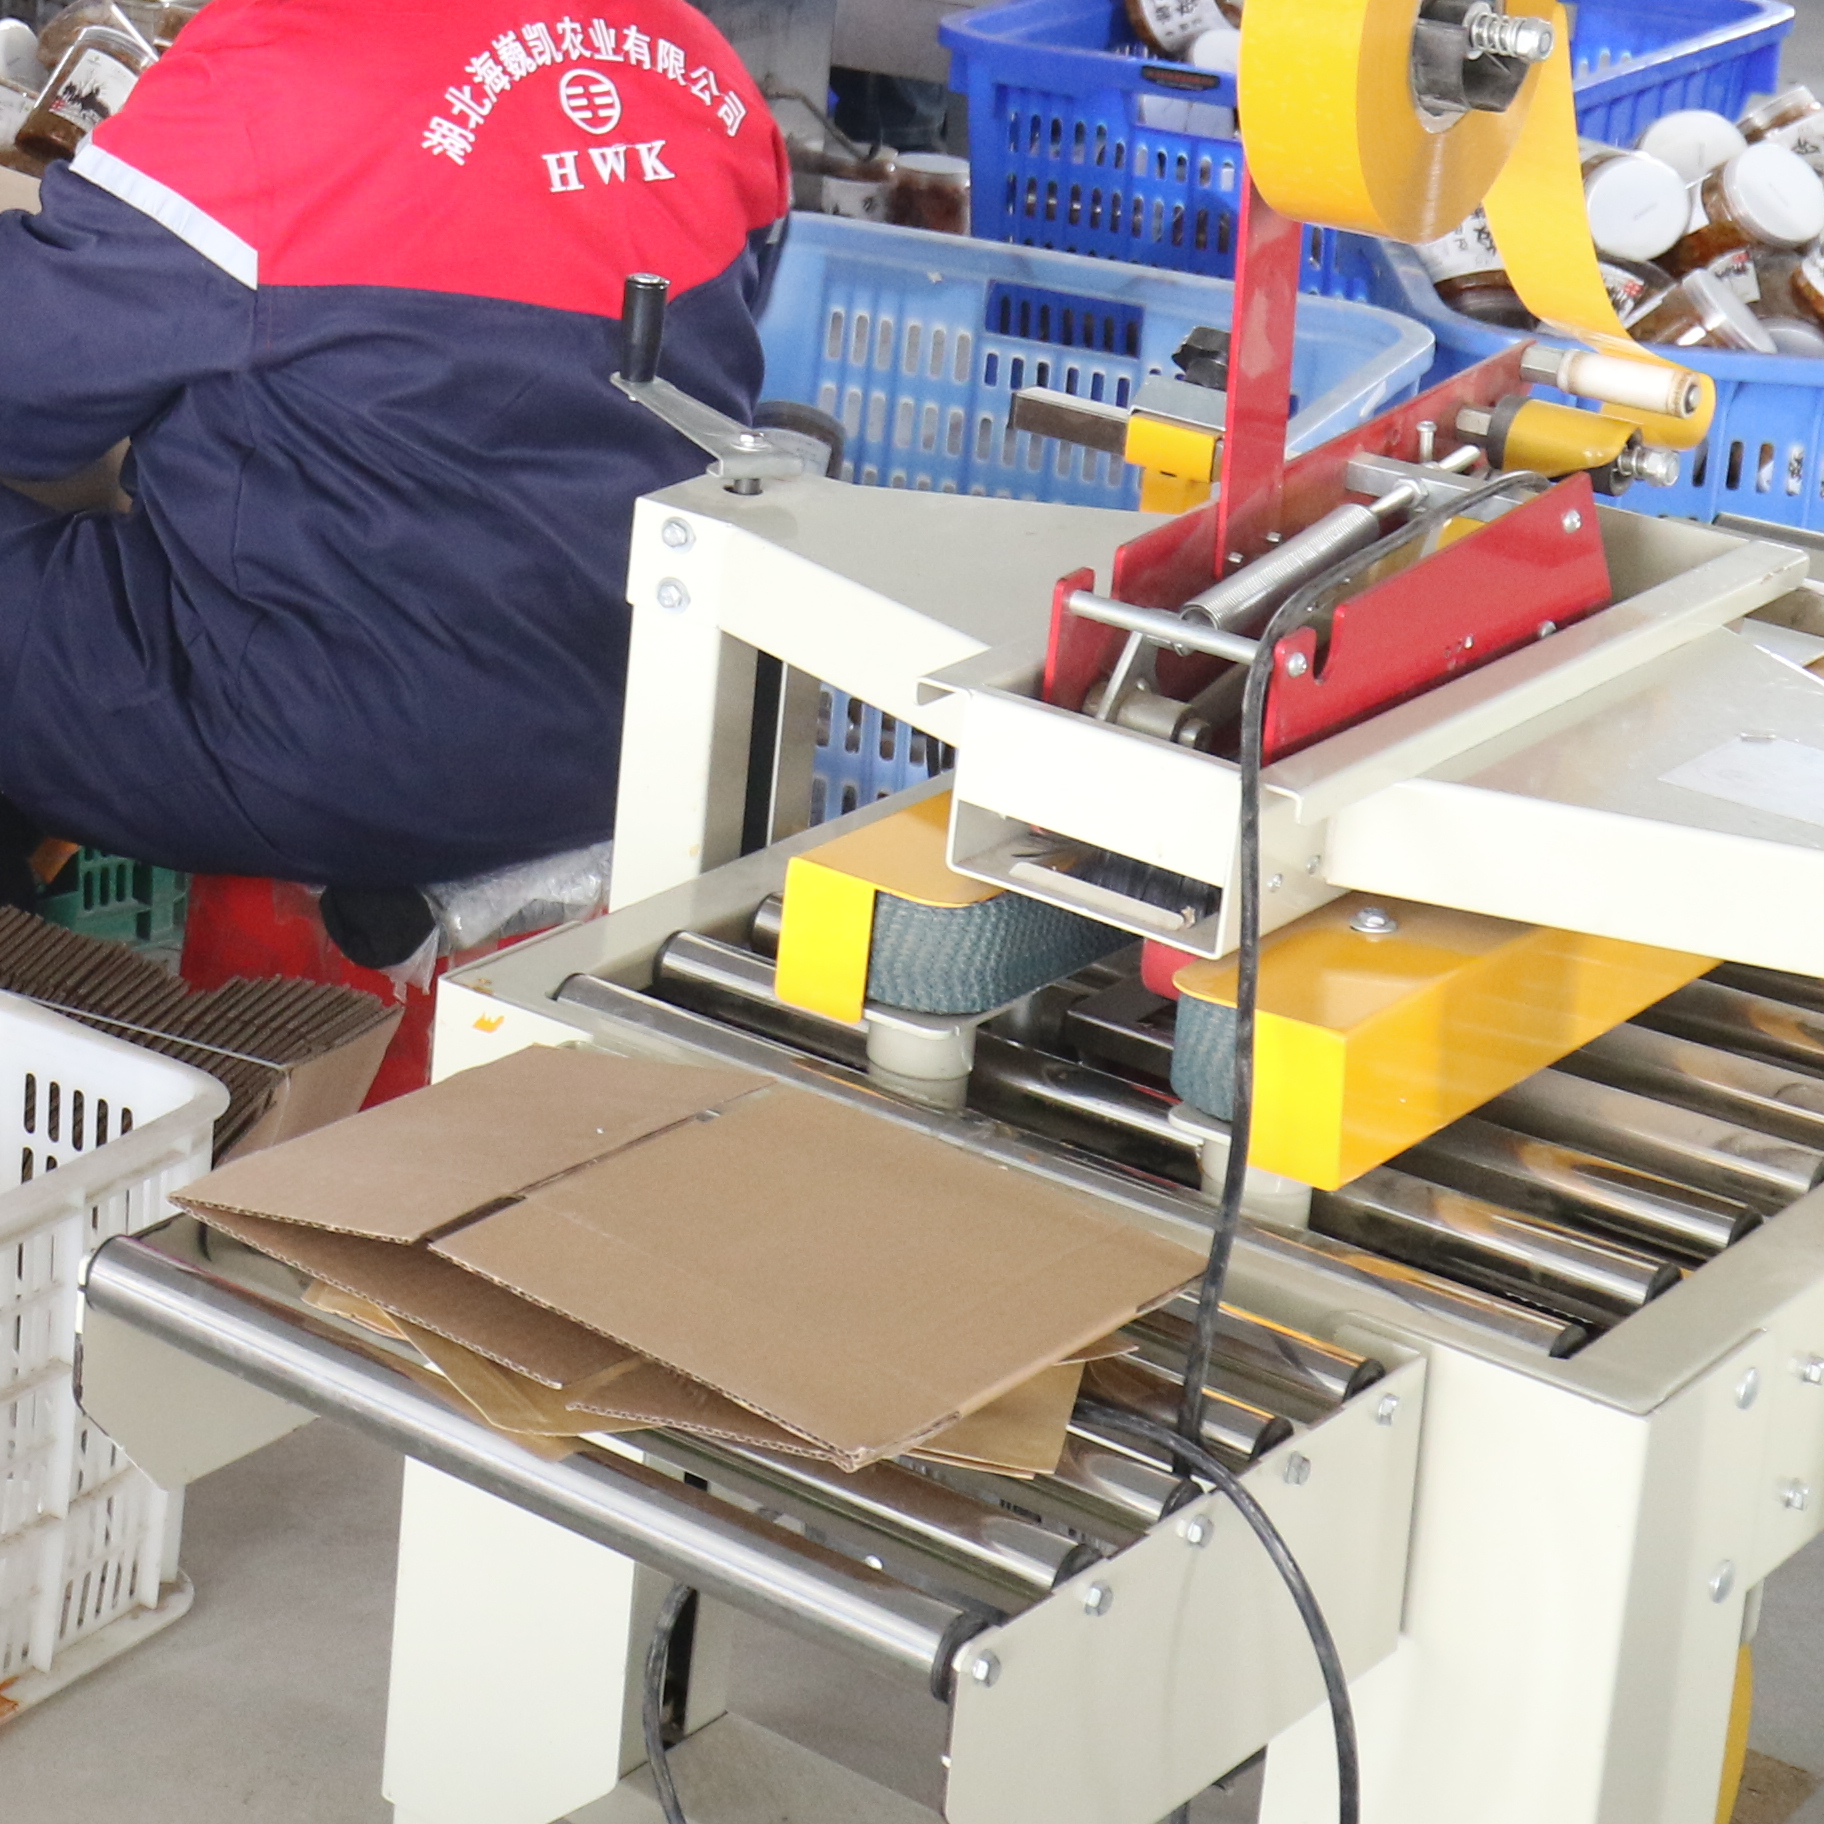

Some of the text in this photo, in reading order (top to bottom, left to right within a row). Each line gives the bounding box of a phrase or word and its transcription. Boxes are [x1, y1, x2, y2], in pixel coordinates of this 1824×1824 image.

[420, 16, 747, 166] 湖北海巍凯农业有限公司
[541, 139, 676, 193] HWK
